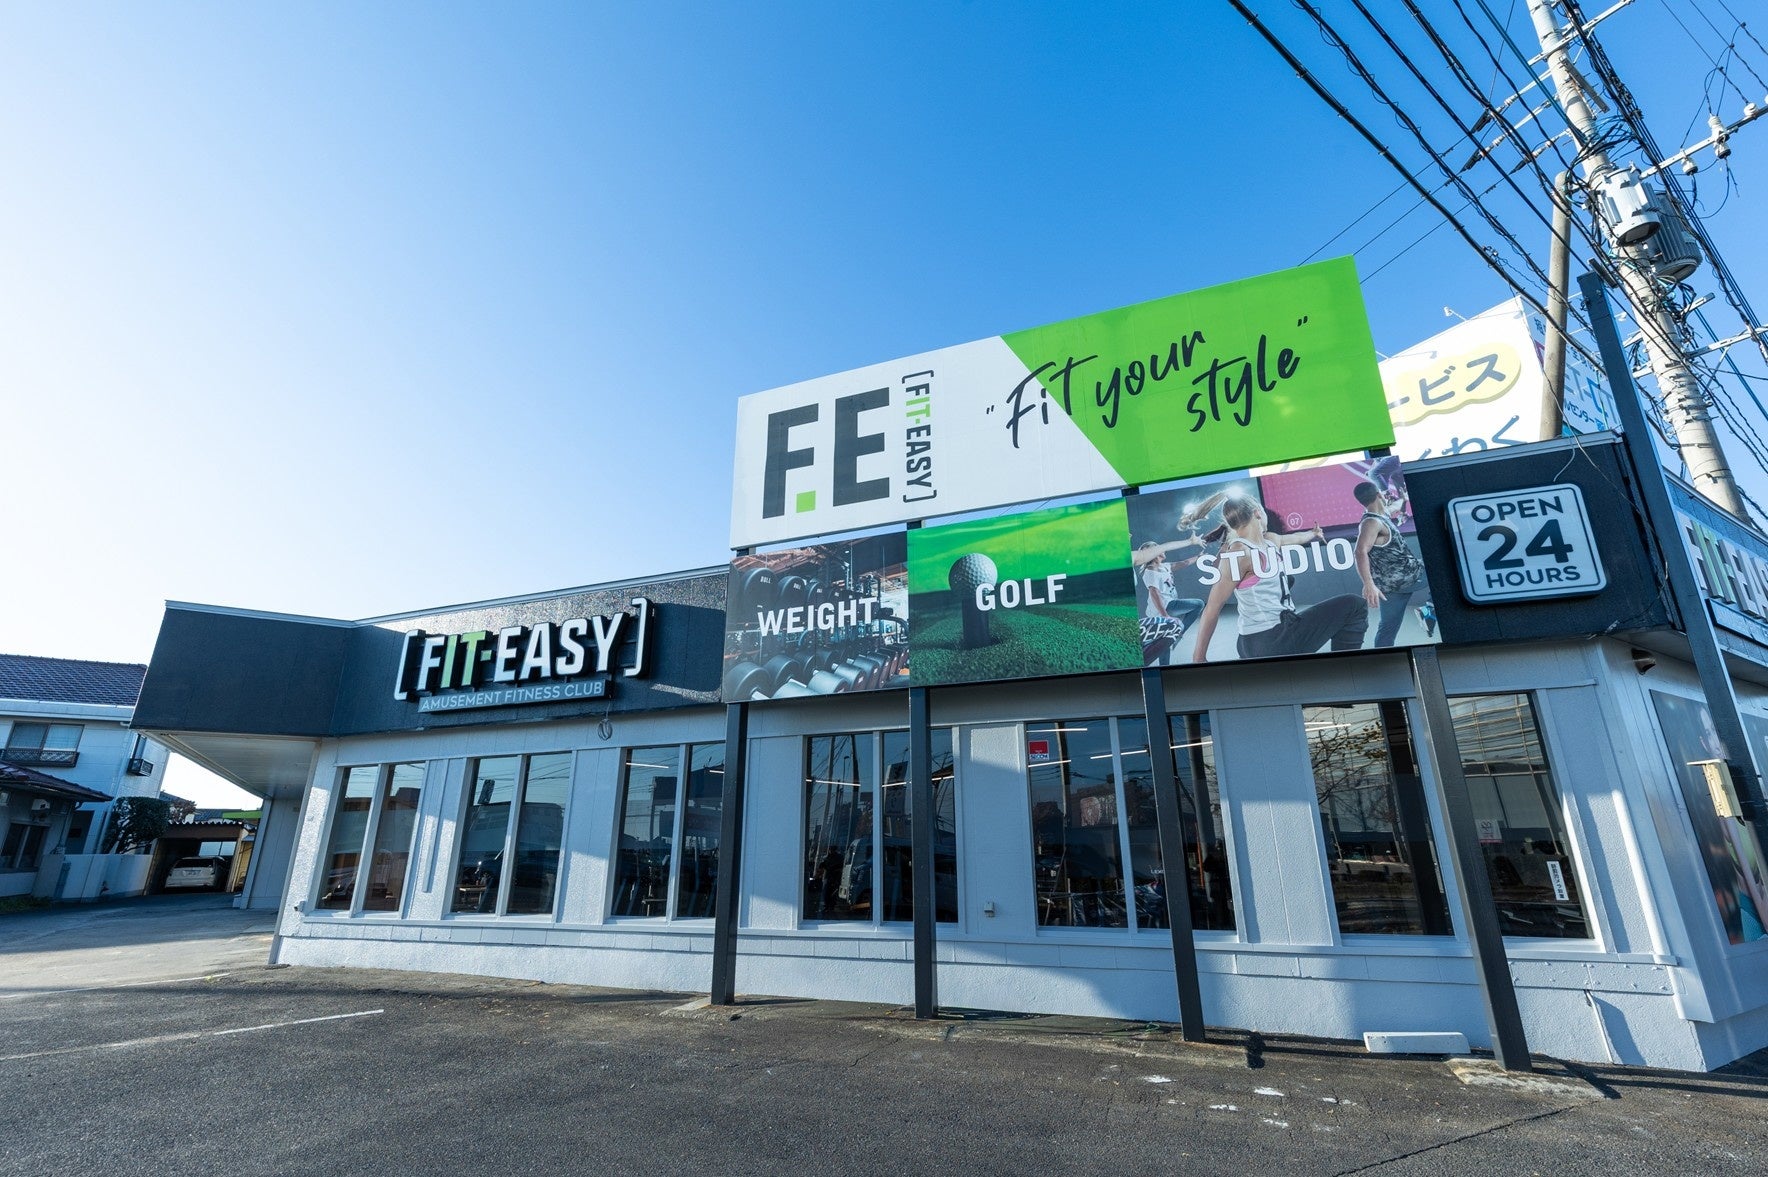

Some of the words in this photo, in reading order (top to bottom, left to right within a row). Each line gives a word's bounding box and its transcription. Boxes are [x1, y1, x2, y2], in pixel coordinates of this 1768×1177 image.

[1096, 331, 1206, 428] your
[1471, 496, 1564, 523] OPEN
[1196, 538, 1354, 585] STUDIO
[1477, 519, 1574, 571] 24
[975, 574, 1067, 611] GOLF
[1486, 566, 1581, 589] HOURS
[757, 597, 878, 636] WEIGHT
[421, 692, 501, 711] AMUSEMENT
[505, 685, 560, 702] FITNESS
[564, 682, 603, 696] CLUB
